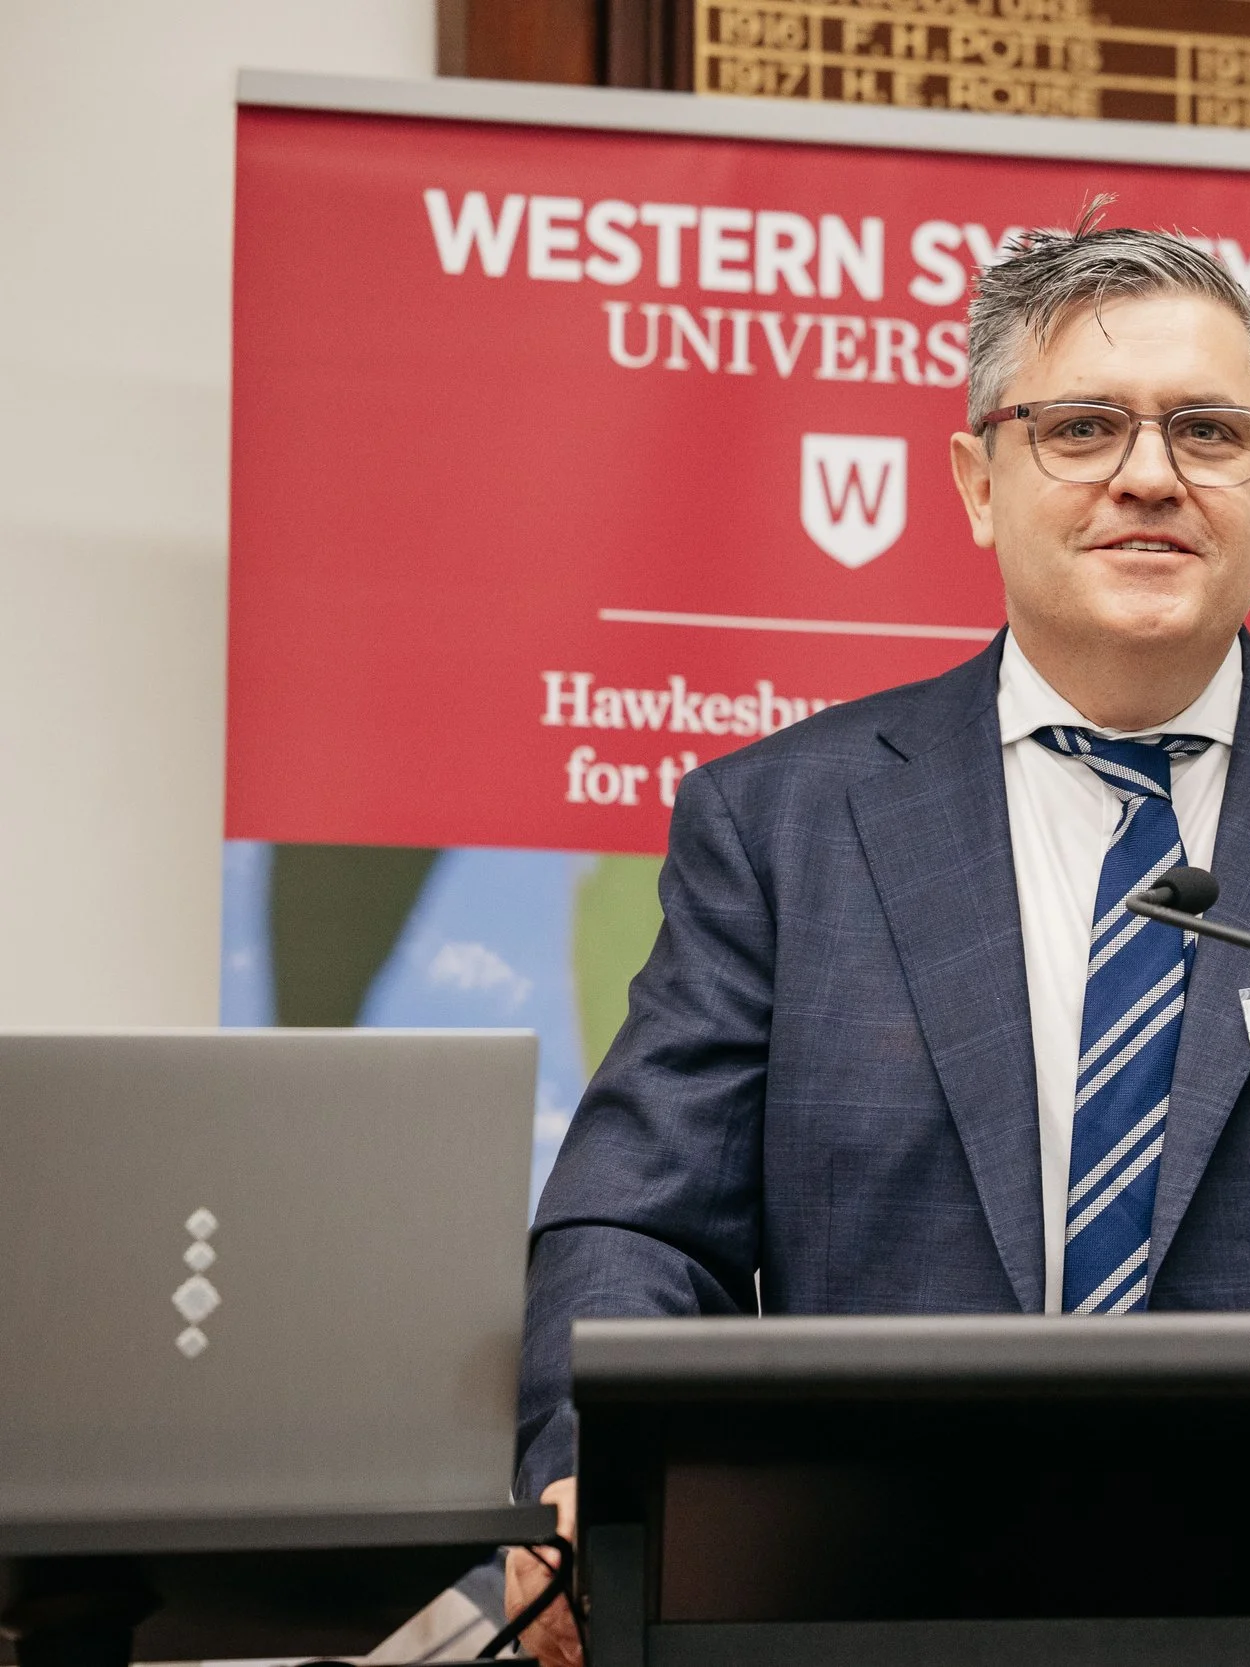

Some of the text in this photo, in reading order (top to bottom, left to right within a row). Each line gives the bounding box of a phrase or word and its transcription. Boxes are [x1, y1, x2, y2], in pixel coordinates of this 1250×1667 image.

[423, 188, 885, 301] WESTERN
[817, 458, 891, 527] W
[565, 744, 649, 806] for
